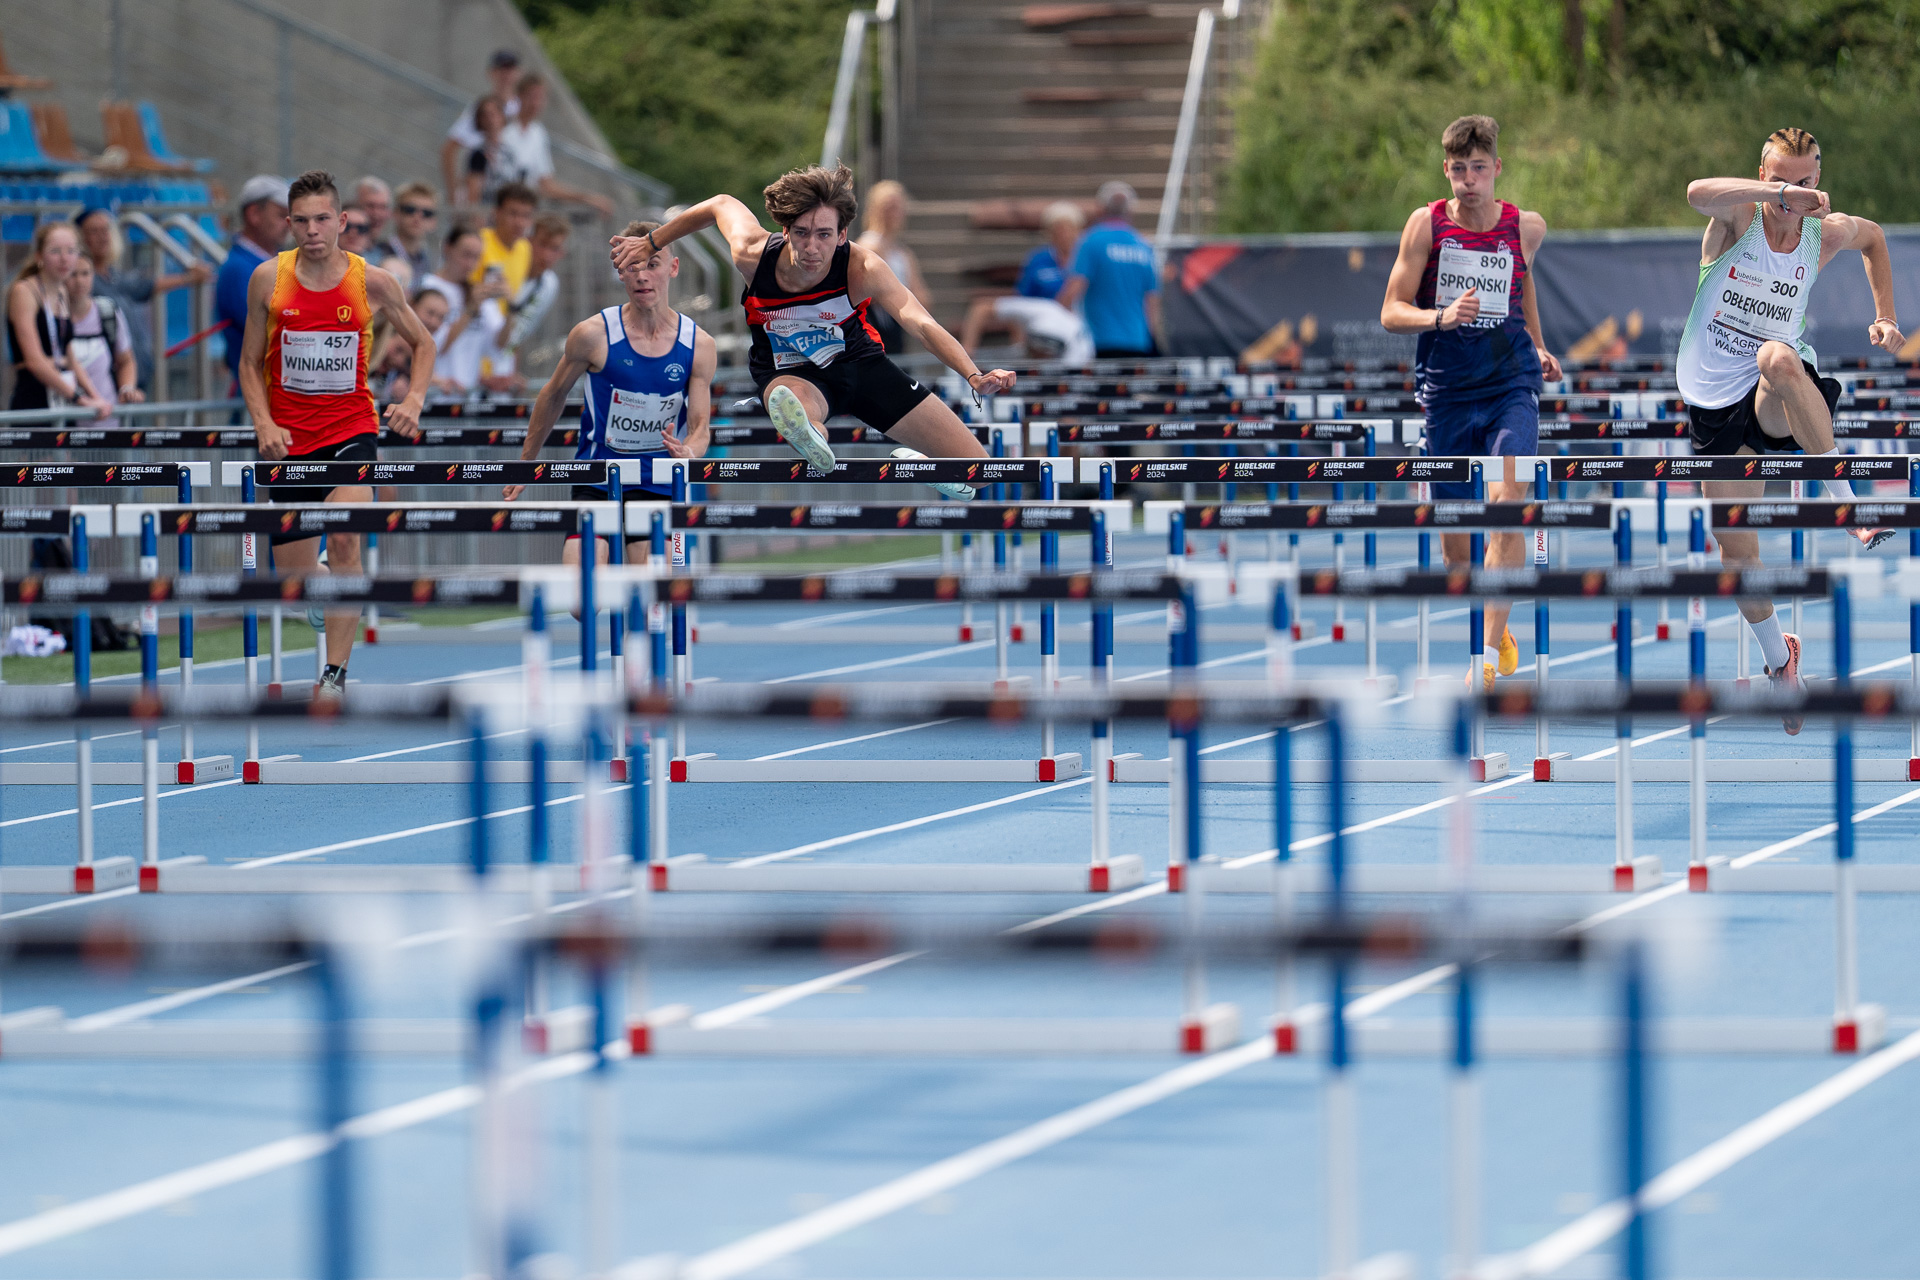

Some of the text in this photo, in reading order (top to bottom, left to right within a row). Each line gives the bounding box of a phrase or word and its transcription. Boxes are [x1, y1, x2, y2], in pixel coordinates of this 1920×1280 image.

[1481, 255, 1507, 270] 890
[1440, 273, 1507, 294] SPROŃSKI
[1770, 281, 1798, 298] 300
[1722, 290, 1793, 323] OBŁĘKOWSKI
[1724, 313, 1750, 327] LUBELSKIE
[324, 335, 352, 348] 457
[284, 355, 353, 372] WINIARSKI
[660, 398, 675, 412] 75
